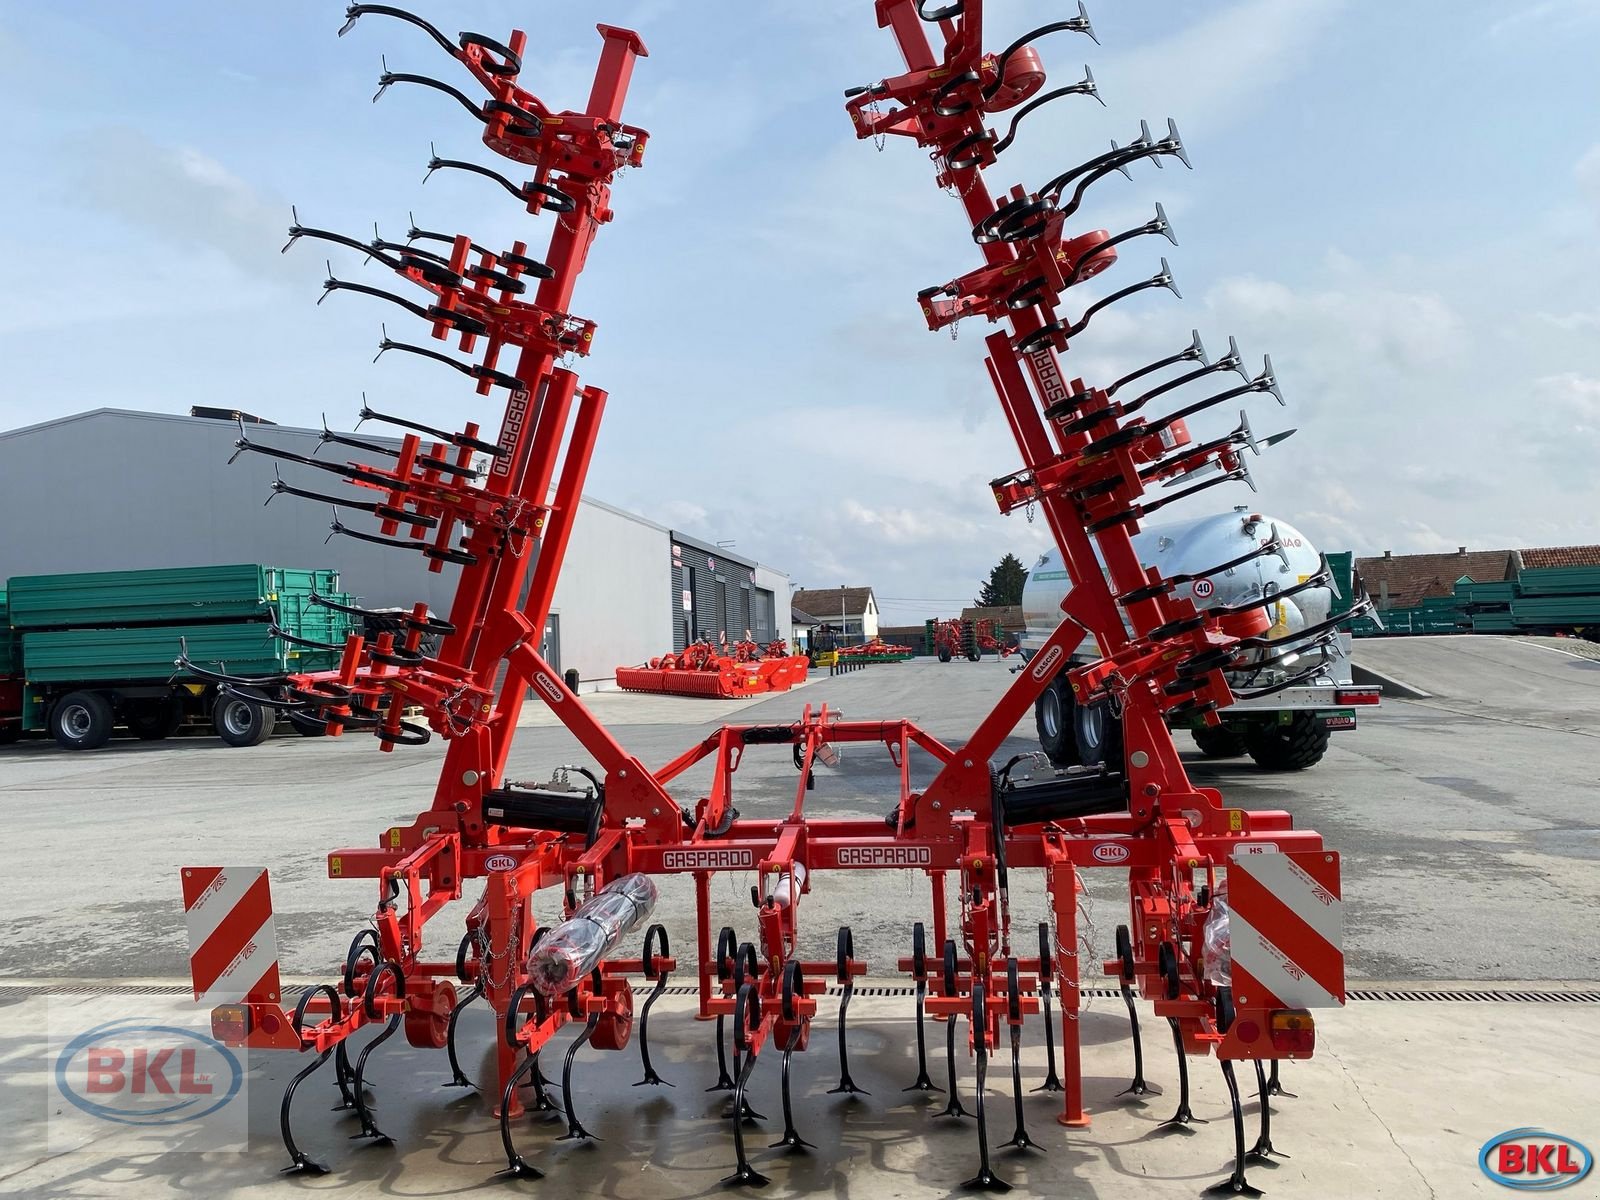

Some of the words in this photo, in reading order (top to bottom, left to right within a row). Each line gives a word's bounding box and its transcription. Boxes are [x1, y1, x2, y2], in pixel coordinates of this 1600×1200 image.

[1196, 582, 1210, 594] 40
[1035, 648, 1059, 676] MASCHIO
[538, 674, 561, 700] MASCHIO
[664, 851, 751, 867] GASPARDO
[838, 848, 930, 864] GASPARDO
[1100, 847, 1124, 857] BKL
[491, 859, 512, 868] BKL
